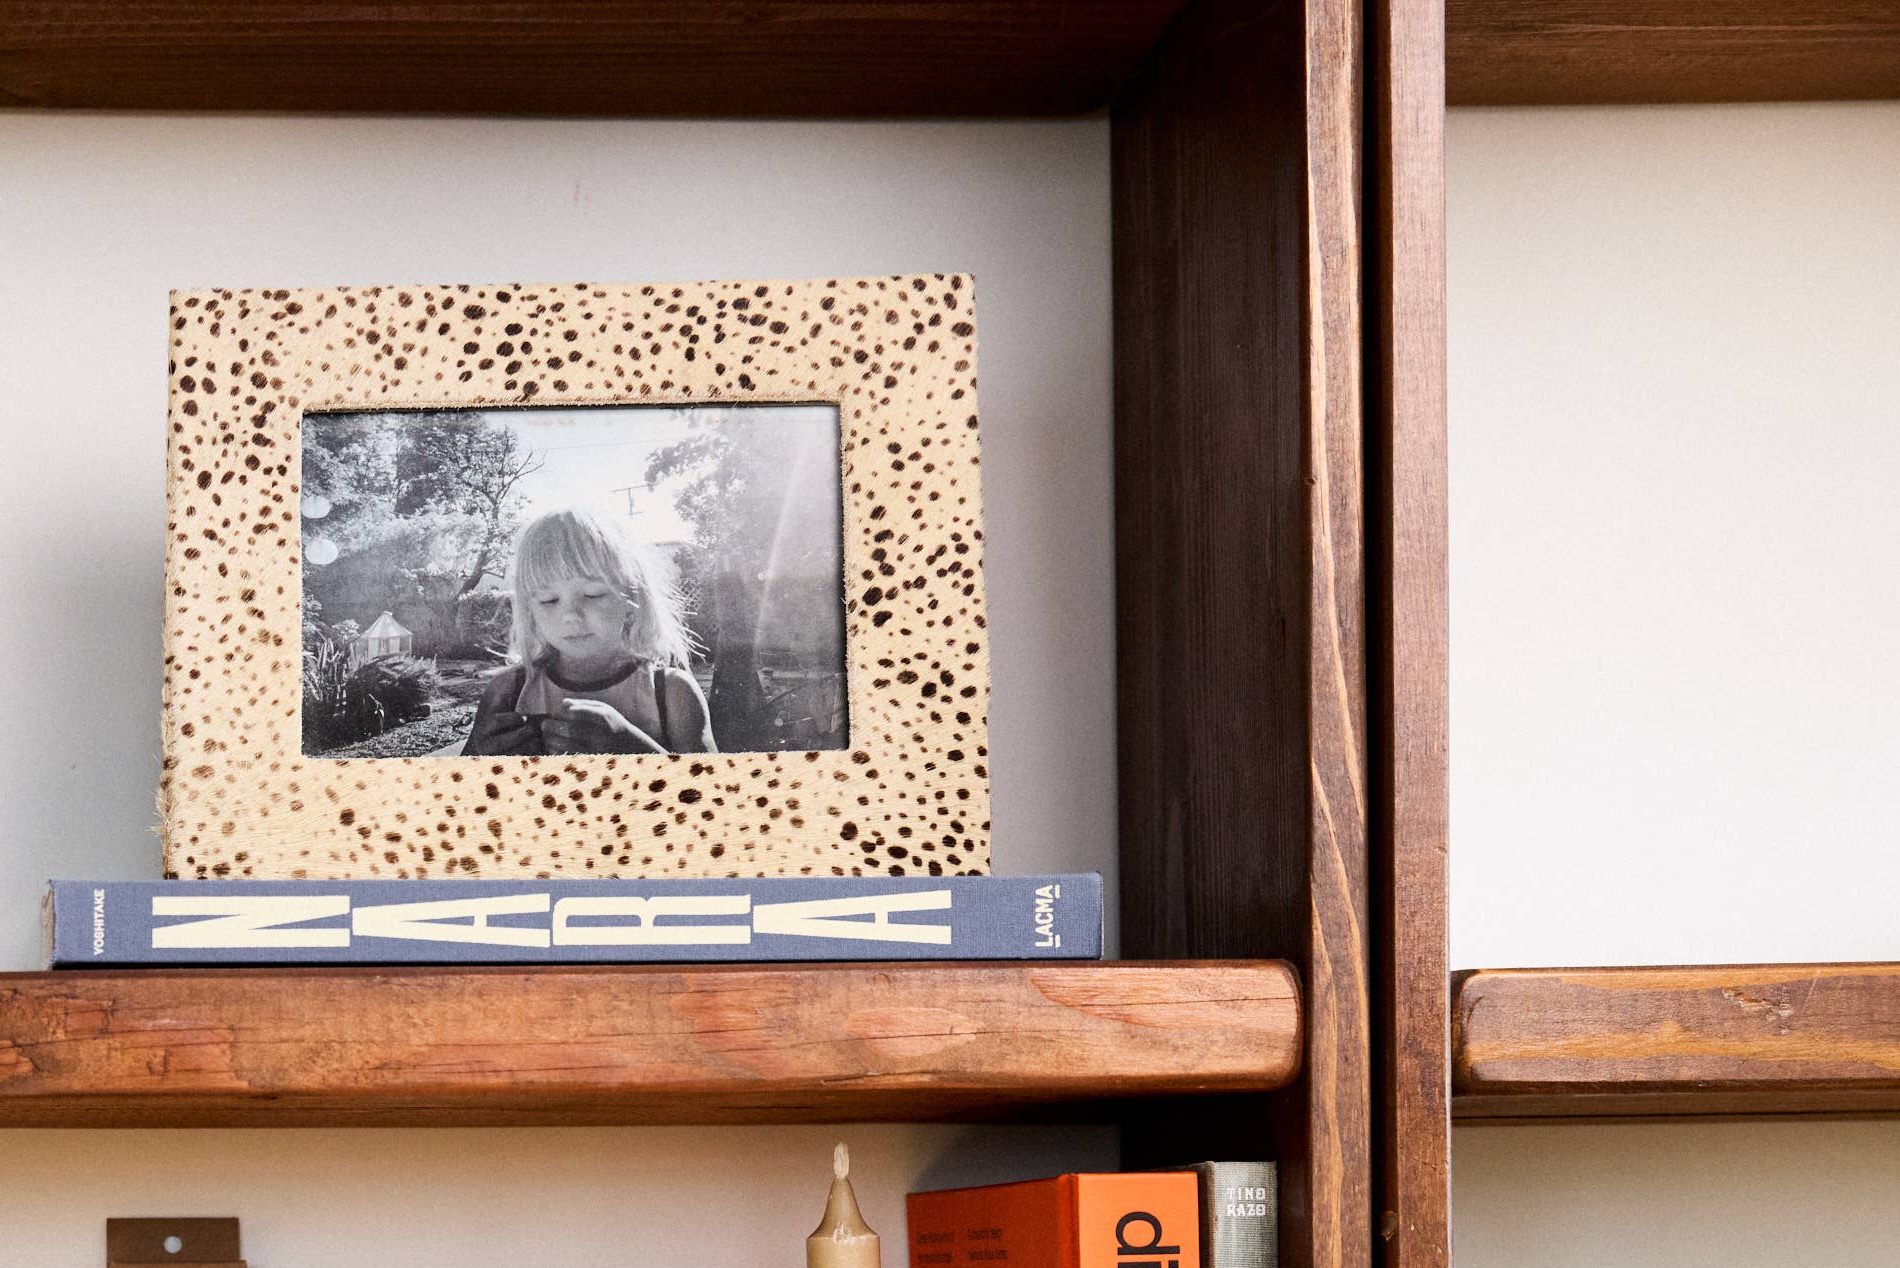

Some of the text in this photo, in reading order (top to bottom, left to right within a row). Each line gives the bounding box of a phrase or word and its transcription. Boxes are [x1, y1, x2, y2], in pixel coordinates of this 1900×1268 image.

[93, 888, 105, 956] YOSHITAKE
[151, 890, 952, 949] NARA
[1035, 884, 1055, 948] LACMA
